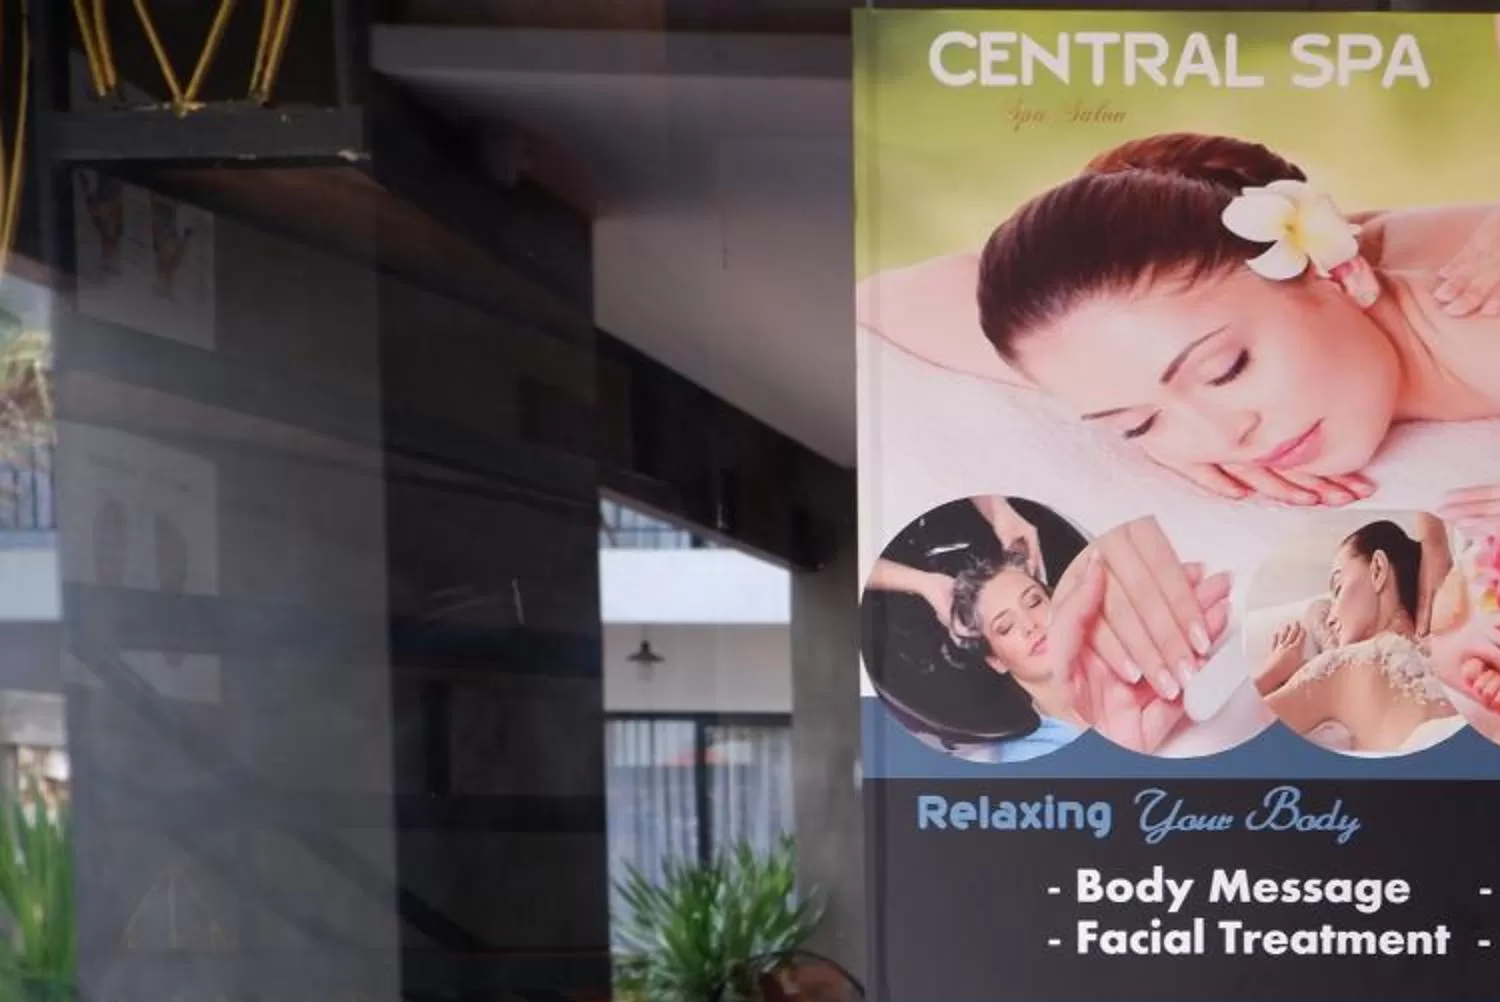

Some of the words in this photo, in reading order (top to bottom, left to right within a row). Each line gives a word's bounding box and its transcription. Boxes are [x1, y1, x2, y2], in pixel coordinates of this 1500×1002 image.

[928, 30, 1266, 89] CENTRAL
[1289, 32, 1431, 90] SPA
[917, 794, 1112, 838] Relaxing
[1133, 786, 1234, 845] Your
[1244, 784, 1362, 845] Body
[1076, 865, 1195, 913] Body
[1208, 868, 1412, 914] Message
[1077, 917, 1205, 955] Facial
[1217, 919, 1452, 956] Treatment
